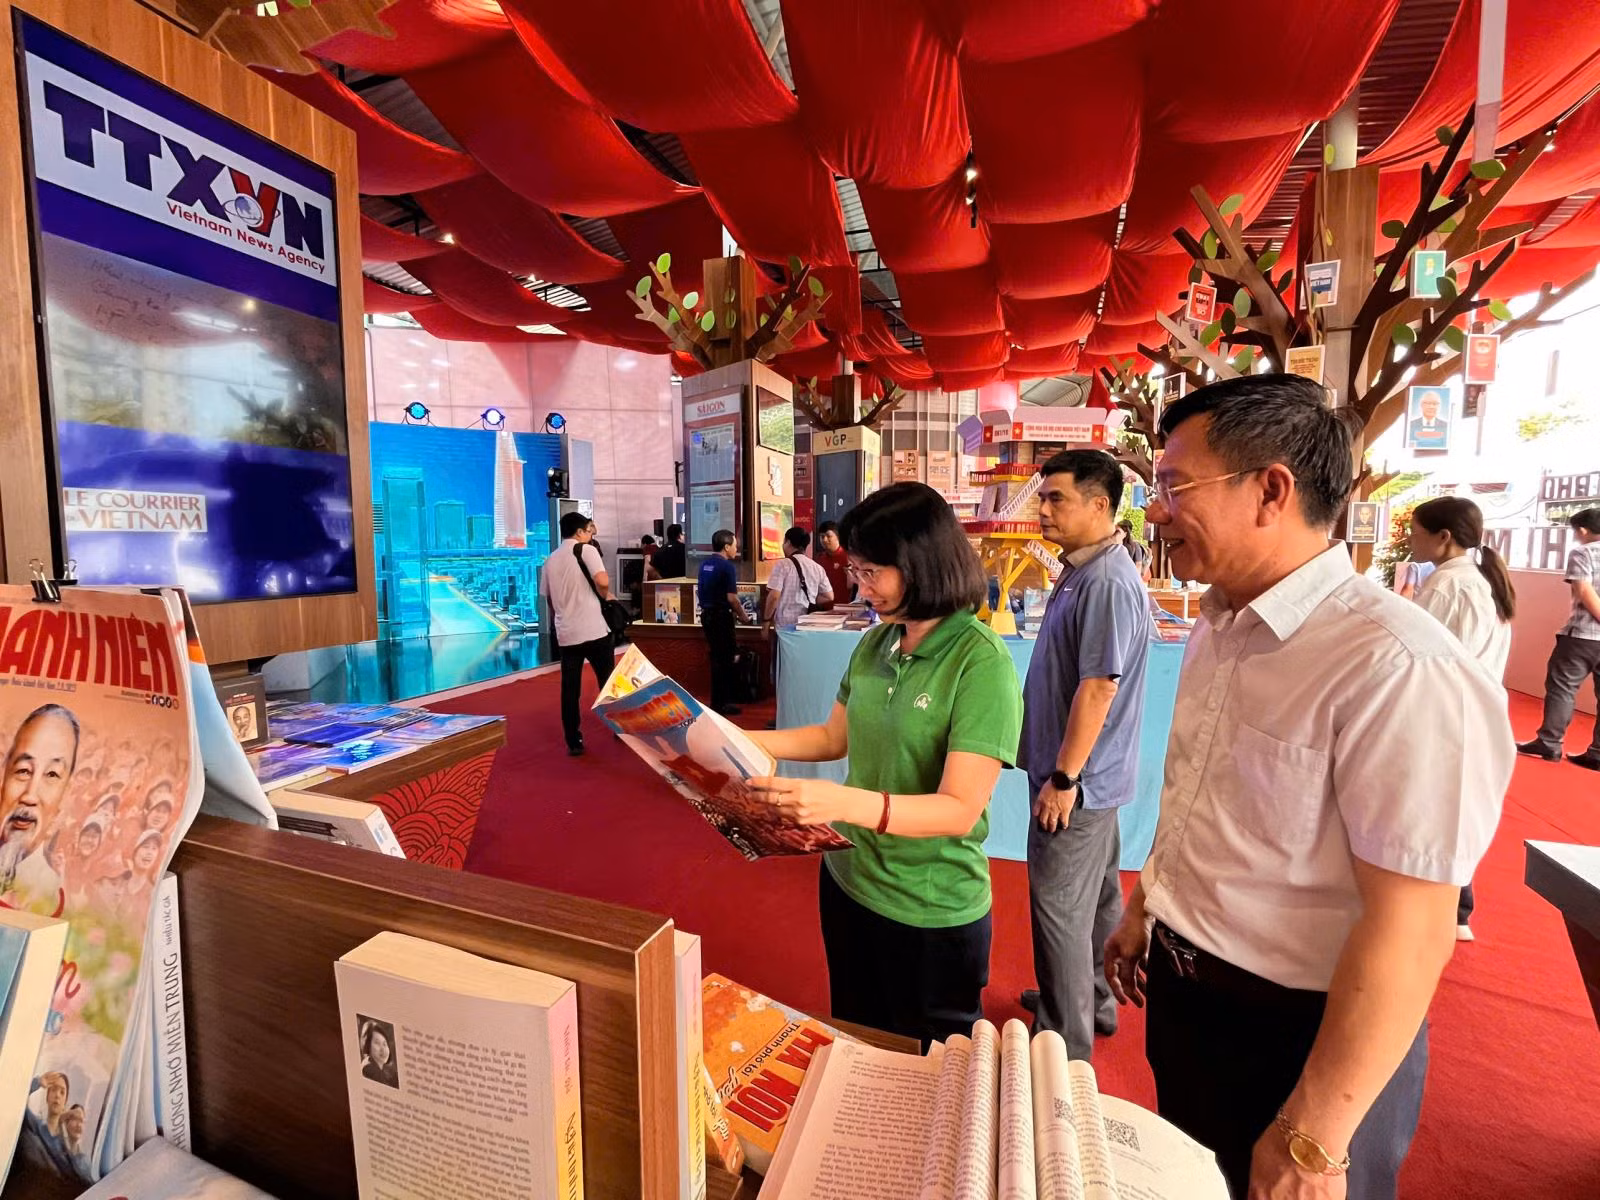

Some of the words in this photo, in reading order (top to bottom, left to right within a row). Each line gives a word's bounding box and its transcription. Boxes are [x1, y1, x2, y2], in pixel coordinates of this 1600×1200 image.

[43, 80, 324, 260] TTXVN
[167, 201, 232, 237] Vietnam
[236, 229, 274, 255] News
[277, 245, 325, 275] Agency
[825, 433, 847, 447] VGP
[64, 490, 89, 507] LE
[96, 491, 201, 512] COURRIER
[78, 508, 203, 531] VIETNAM
[94, 611, 178, 696] NIÊN
[163, 953, 180, 1011] TRUNG
[754, 1046, 774, 1068] phố
[741, 1063, 757, 1077] tôi
